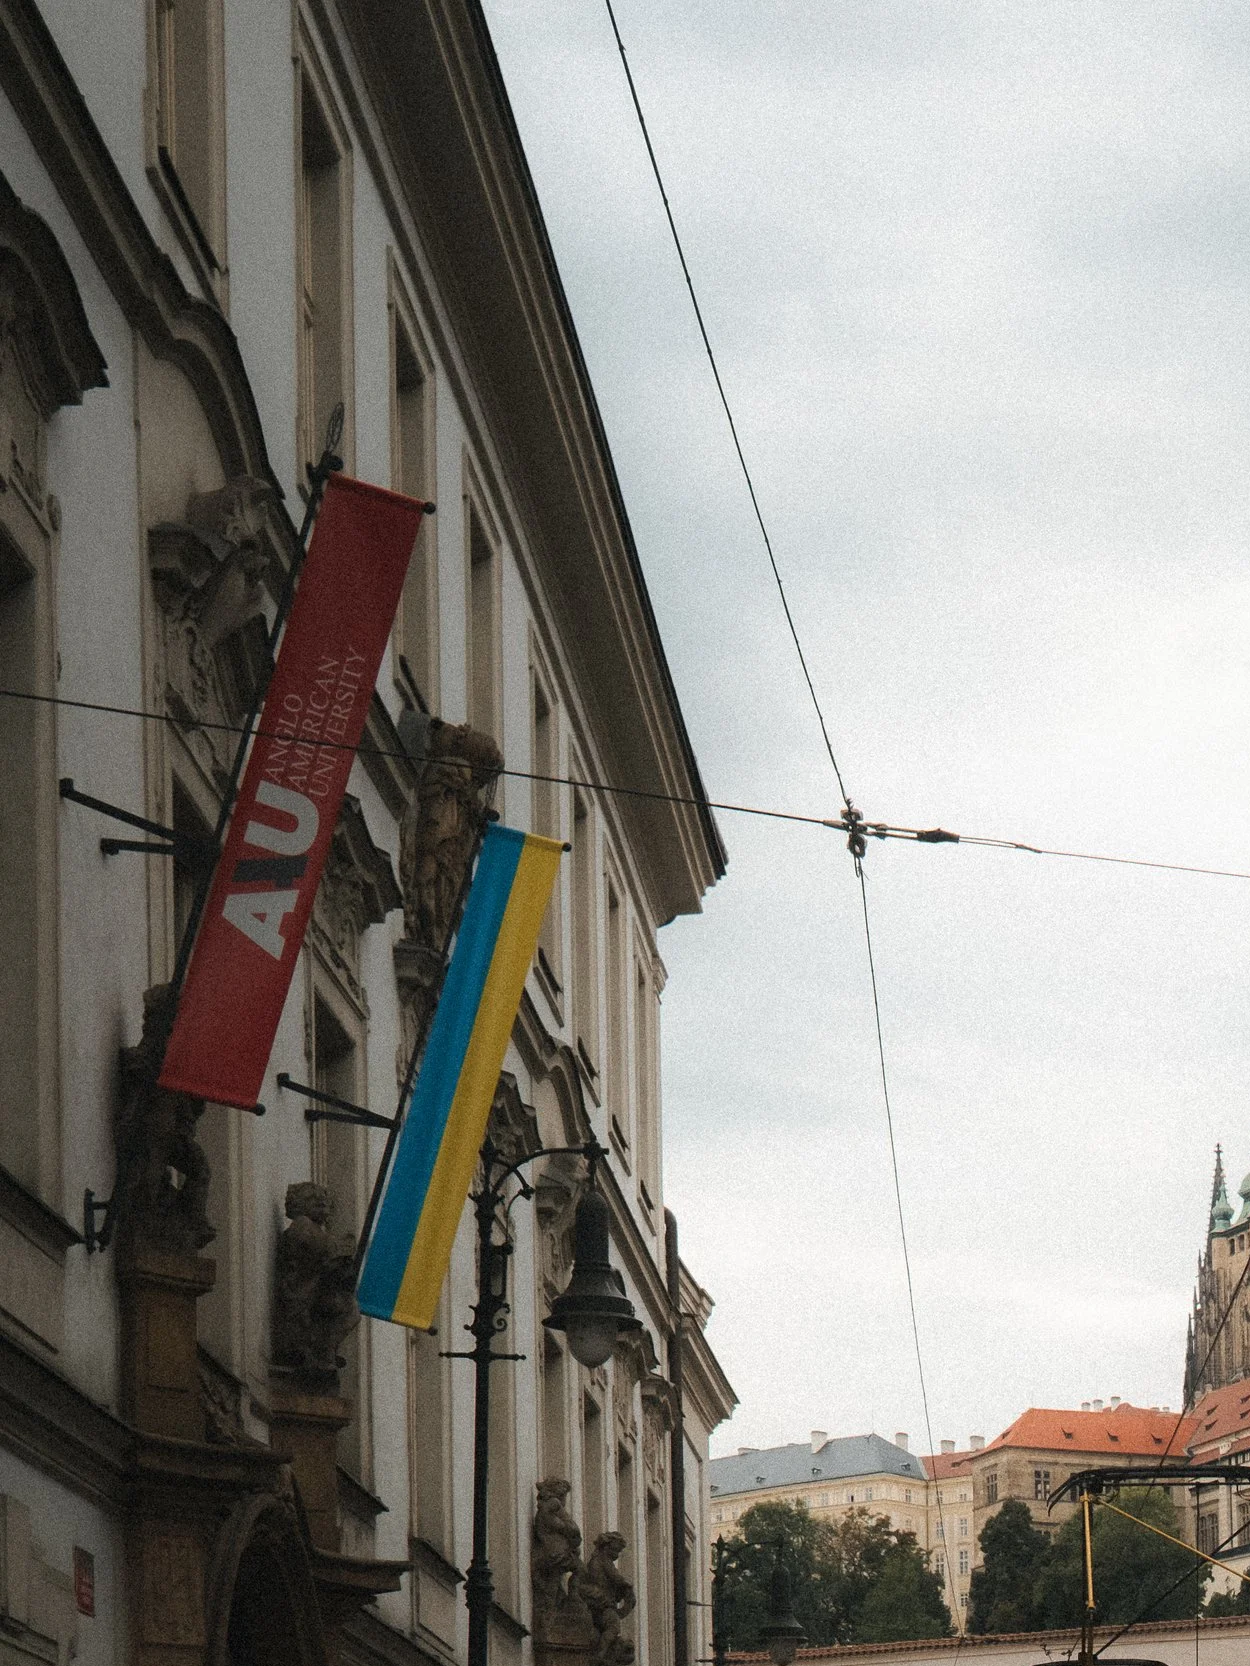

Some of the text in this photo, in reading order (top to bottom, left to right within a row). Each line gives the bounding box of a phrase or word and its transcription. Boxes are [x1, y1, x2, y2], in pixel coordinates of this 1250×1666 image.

[265, 694, 303, 784] ANGLO
[288, 655, 340, 792] AMERICAN
[309, 647, 366, 797] UNIVERSITY
